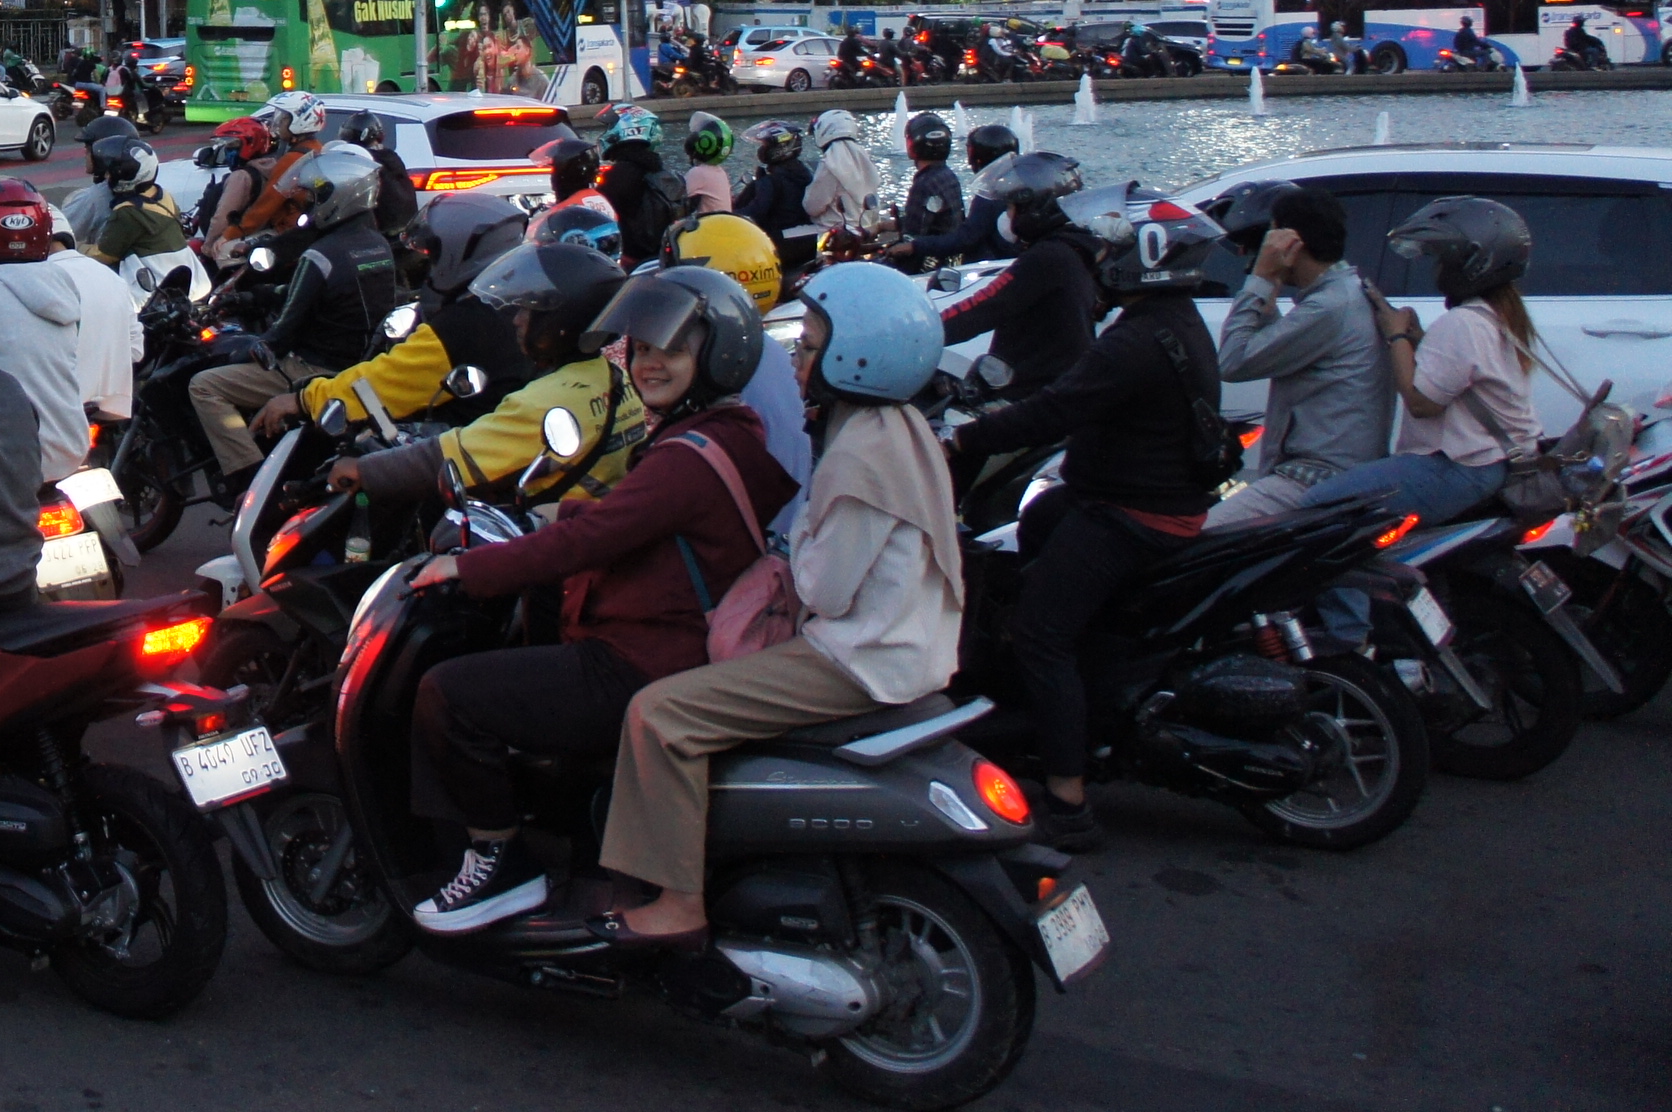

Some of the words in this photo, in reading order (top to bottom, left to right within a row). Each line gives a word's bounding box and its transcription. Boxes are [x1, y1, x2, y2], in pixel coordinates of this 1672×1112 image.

[354, 0, 376, 22] Gak
[1139, 223, 1167, 268] 0
[181, 757, 193, 777] B
[240, 731, 272, 757] UFZ
